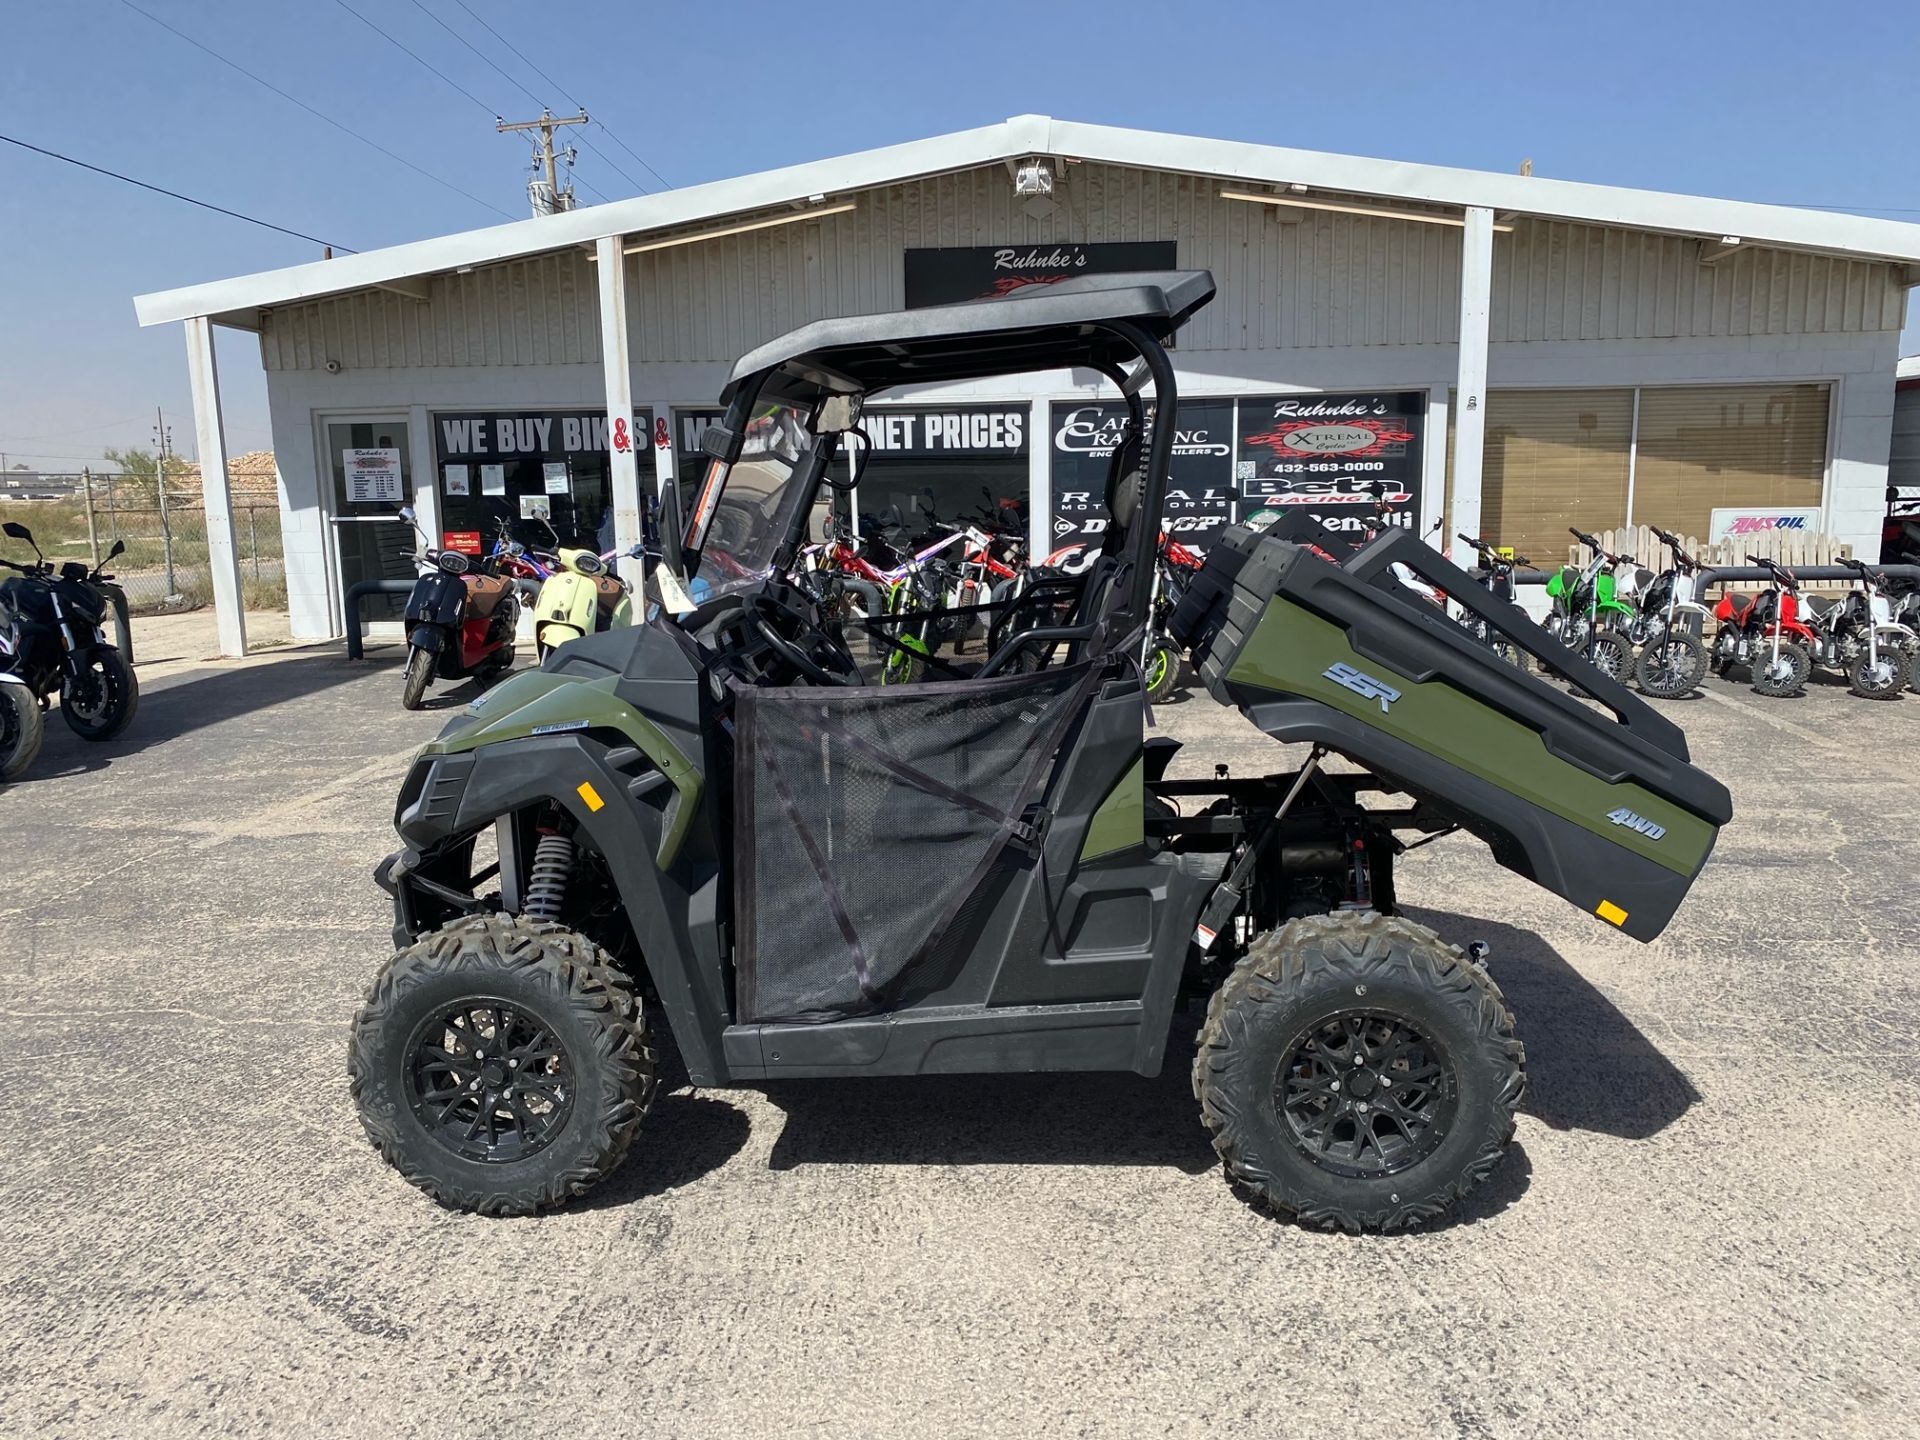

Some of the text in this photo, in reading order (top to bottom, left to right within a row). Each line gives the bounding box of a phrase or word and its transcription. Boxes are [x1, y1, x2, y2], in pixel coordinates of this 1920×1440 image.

[994, 247, 1087, 270] Ruhnke's
[1274, 398, 1388, 418] Ruhnke's
[443, 420, 488, 453] WE
[496, 418, 552, 452] BUY
[562, 417, 648, 450] BIKS
[614, 417, 633, 453] &
[925, 413, 1022, 448] PRICES
[1291, 432, 1372, 445] XTREME
[1274, 462, 1384, 473] 432-563-0000
[1243, 477, 1404, 498] Beta
[1267, 495, 1363, 503] RACING
[1727, 516, 1805, 534] AMSOIL
[1321, 662, 1402, 714] SSR
[1606, 808, 1666, 840] 4WD
